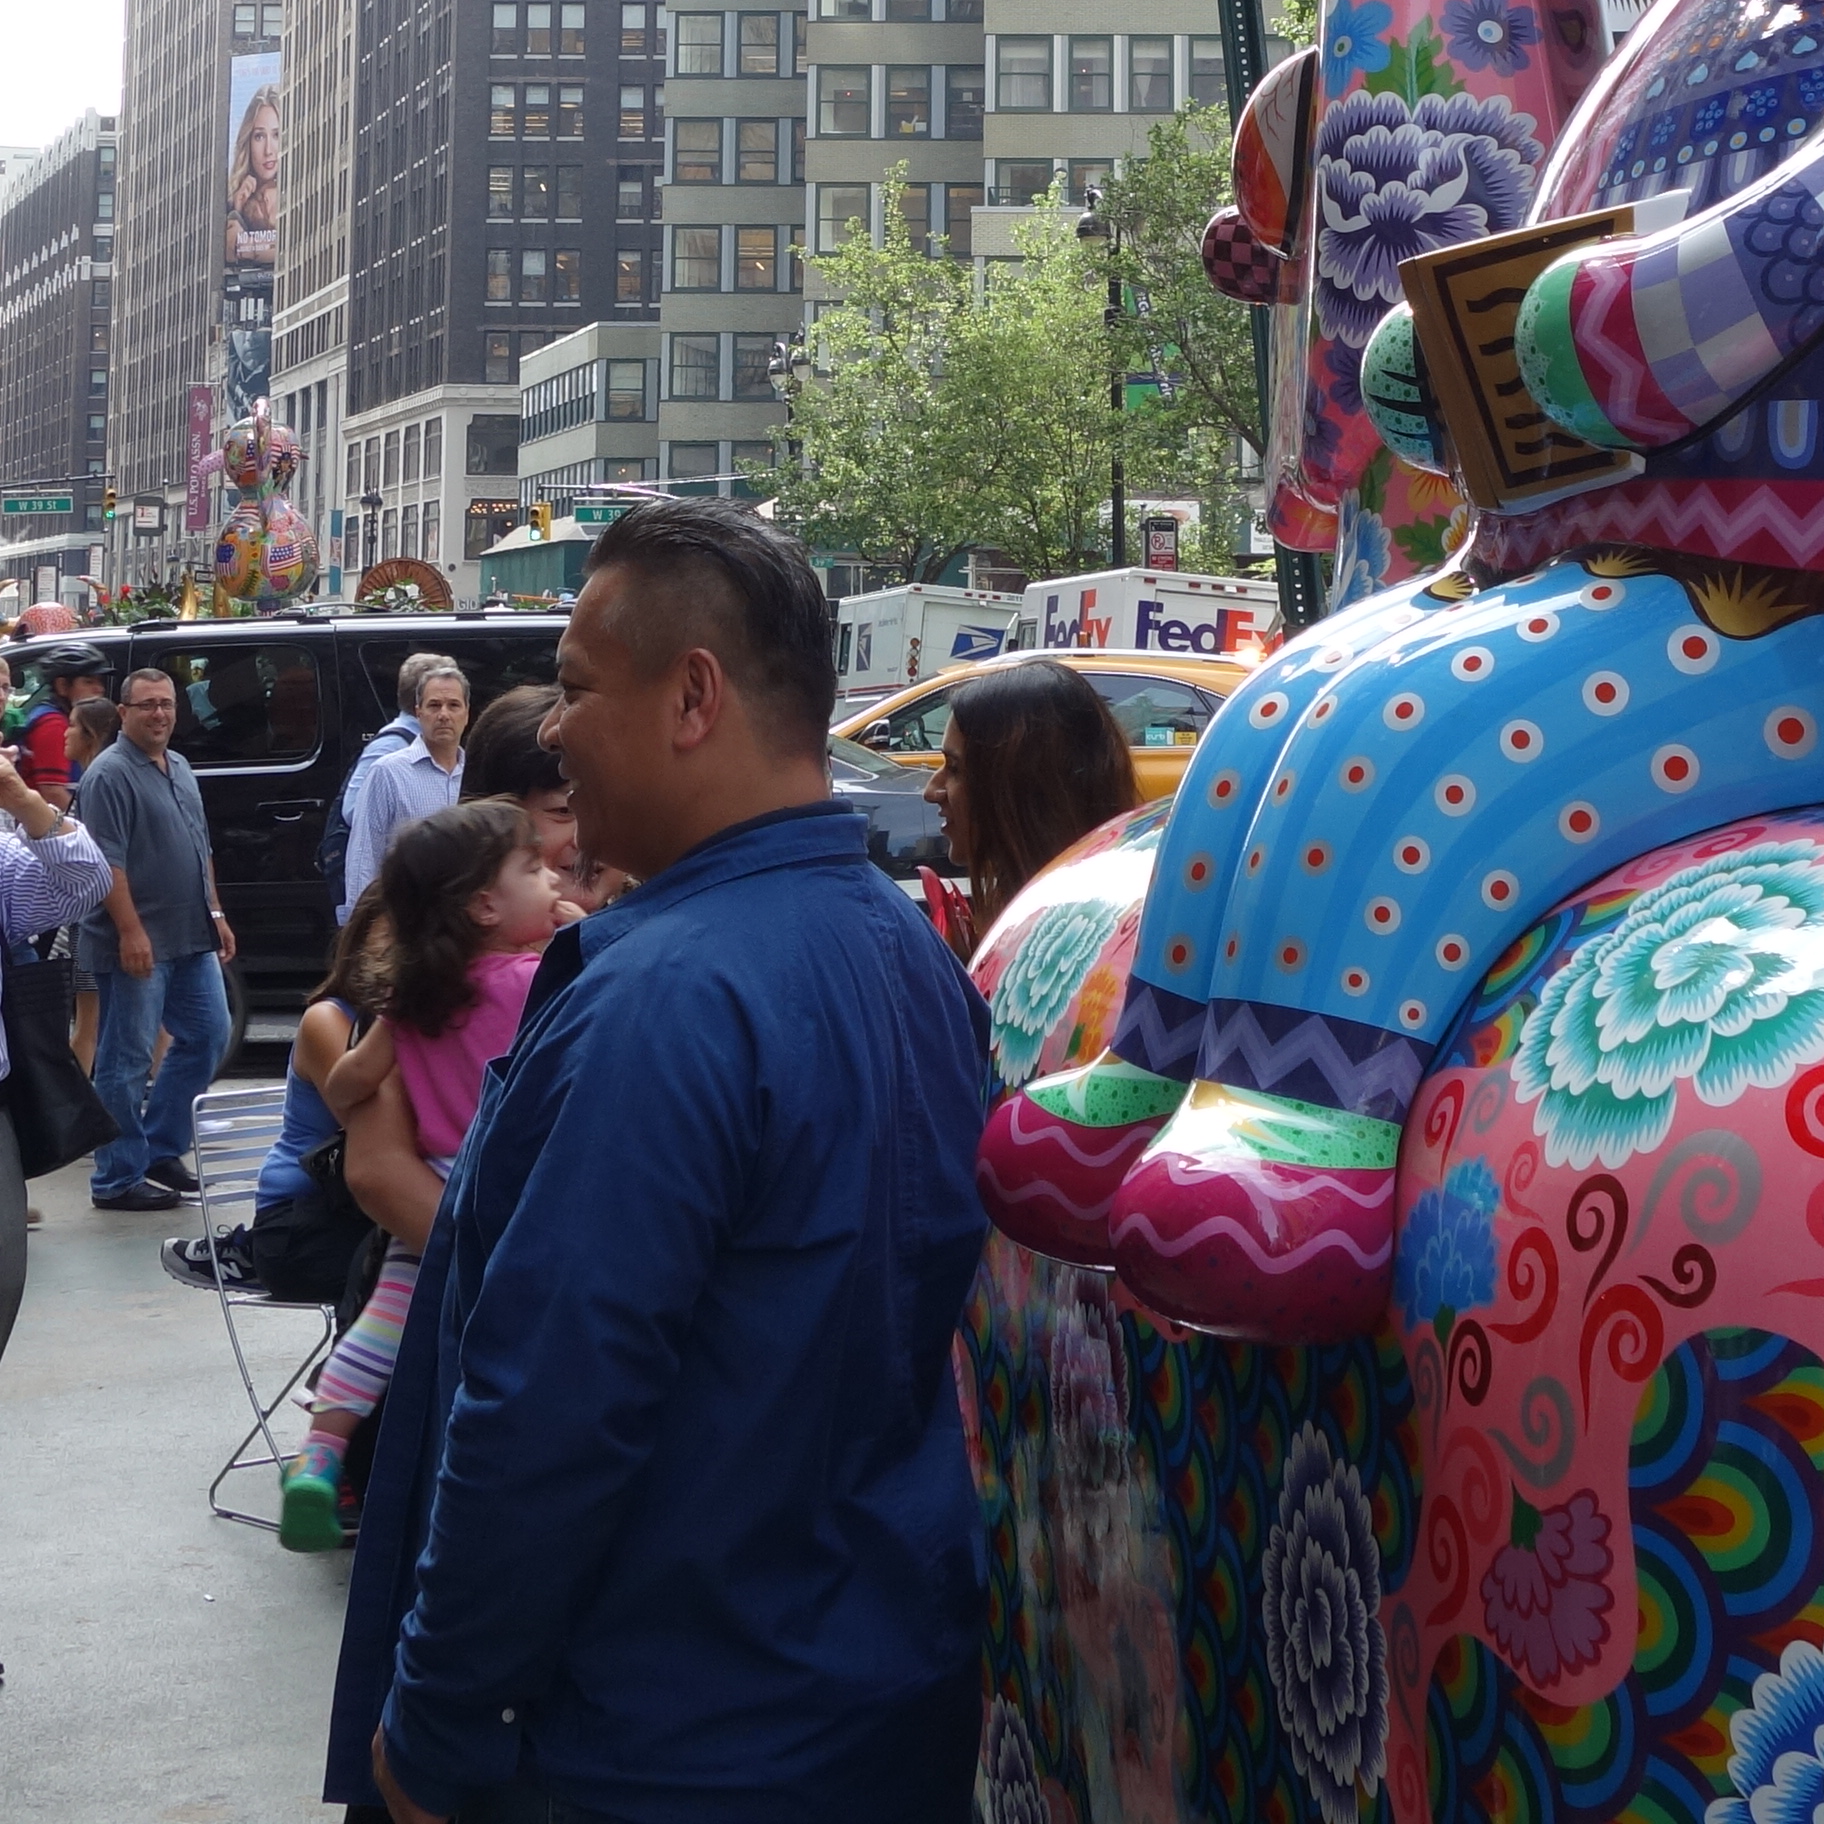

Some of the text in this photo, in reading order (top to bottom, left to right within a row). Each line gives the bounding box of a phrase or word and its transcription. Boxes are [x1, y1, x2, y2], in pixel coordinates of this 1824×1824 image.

[237, 229, 277, 244] NO TOMOR
[19, 499, 57, 511] W 39 St
[592, 509, 602, 521] W
[1146, 732, 1165, 740] curb
